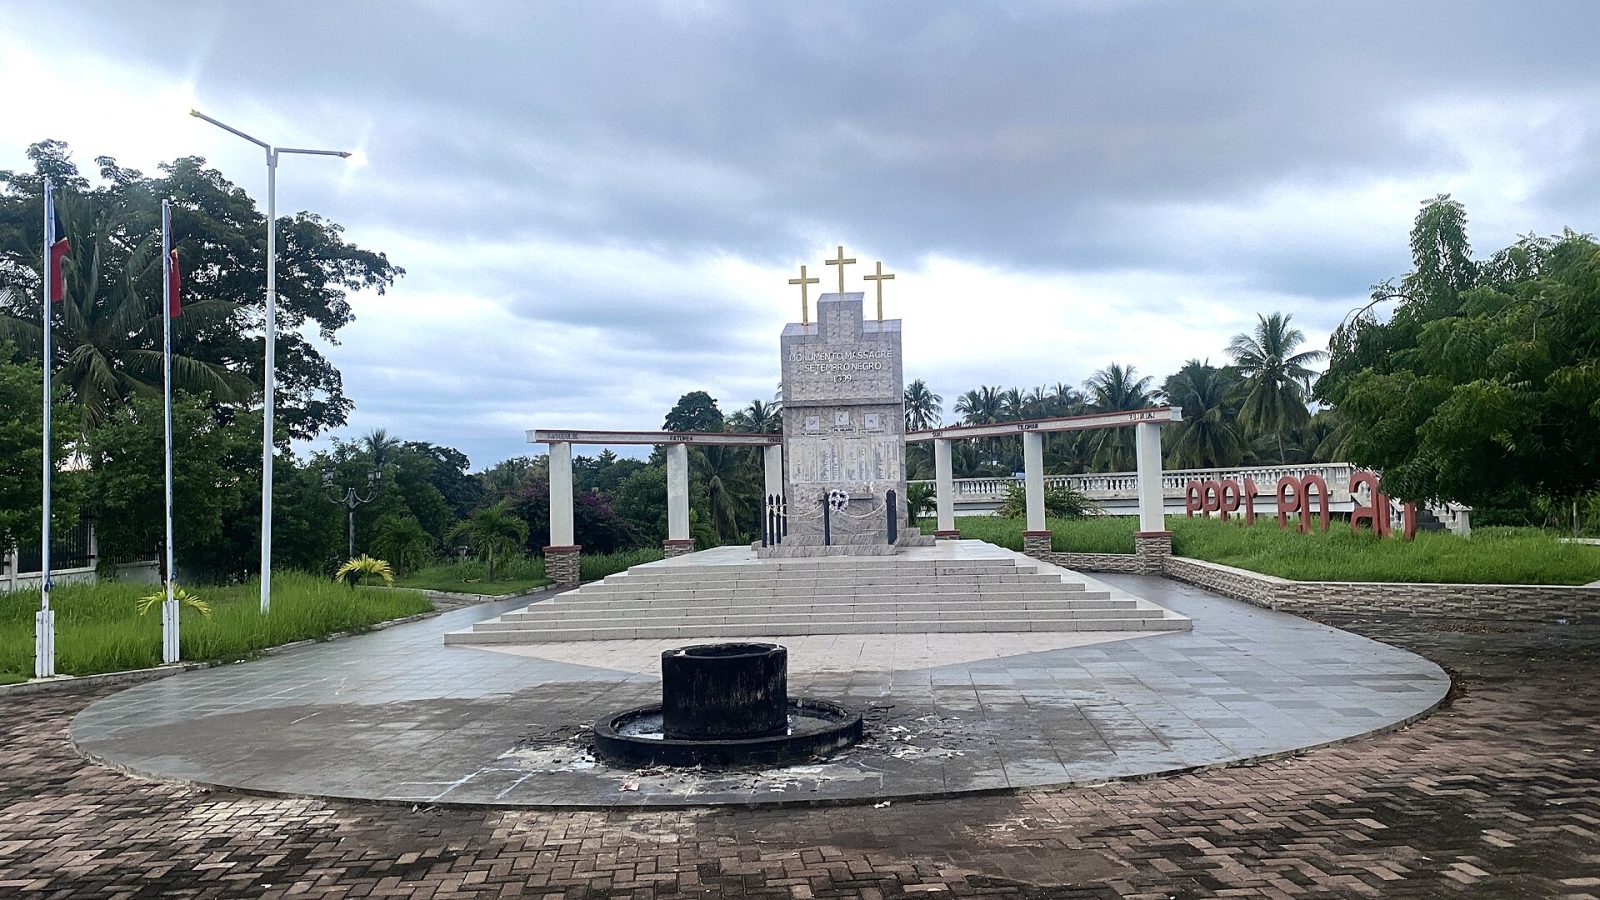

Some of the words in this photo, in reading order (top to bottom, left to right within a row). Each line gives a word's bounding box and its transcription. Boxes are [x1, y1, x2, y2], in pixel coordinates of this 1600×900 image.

[845, 349, 893, 360] MASSACRE
[804, 363, 850, 372] SETEMBRO
[851, 362, 882, 371] NEGRO
